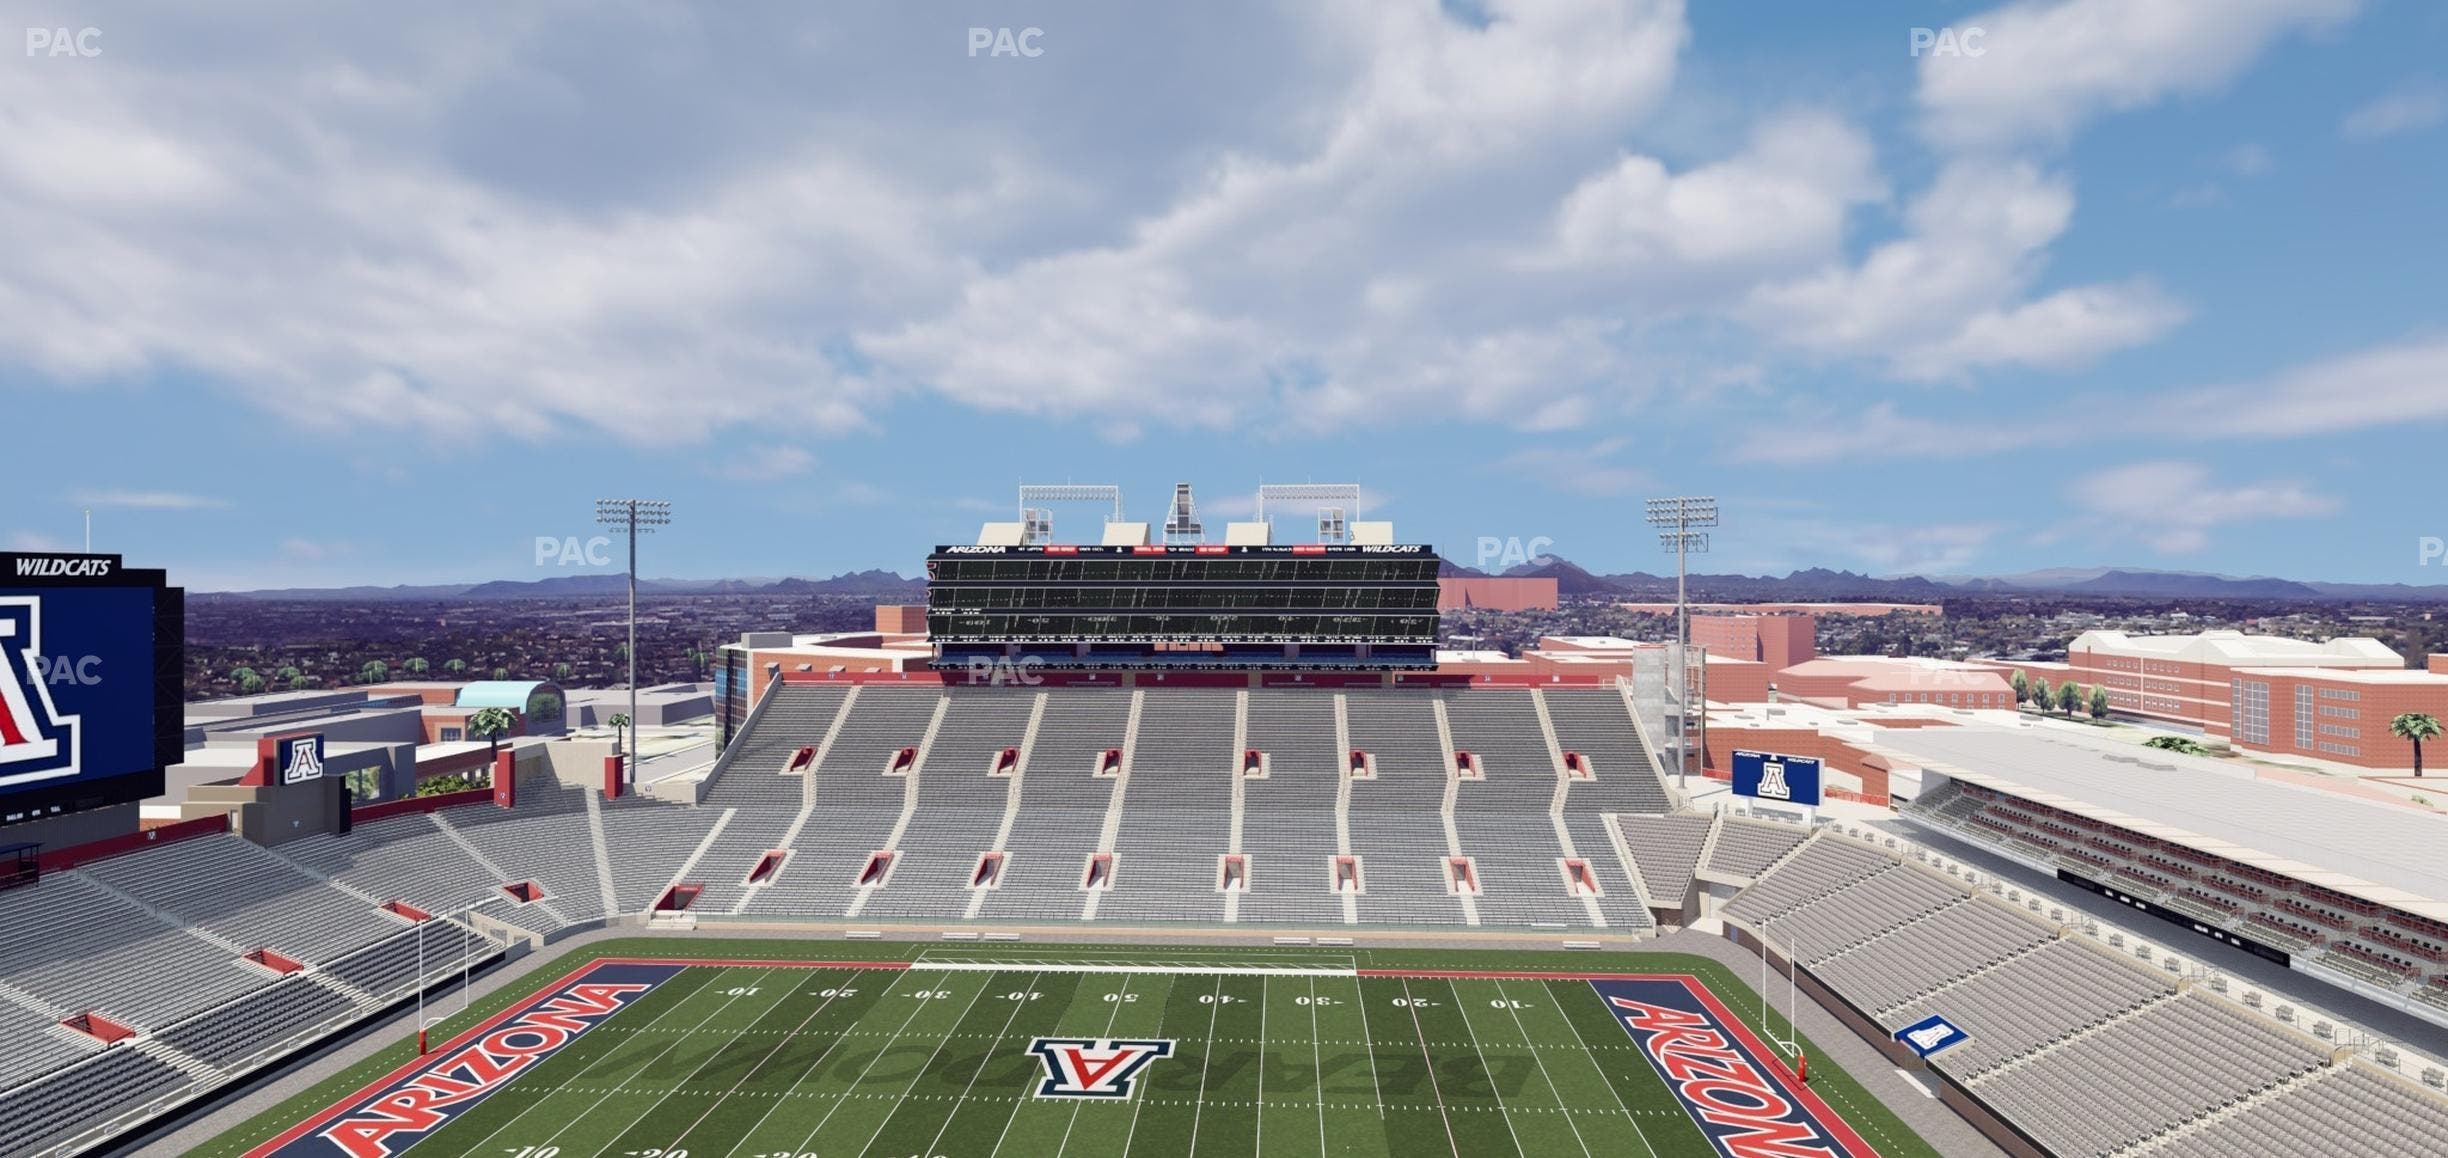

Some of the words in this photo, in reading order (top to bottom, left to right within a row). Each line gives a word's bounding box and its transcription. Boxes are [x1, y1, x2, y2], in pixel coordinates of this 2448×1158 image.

[945, 546, 1006, 554] ARIZONA
[1362, 545, 1422, 554] WILDCATS
[15, 558, 111, 577] WILDCATS
[284, 738, 323, 784] A
[1757, 761, 1790, 800] A
[315, 983, 653, 1158] ARIZONA
